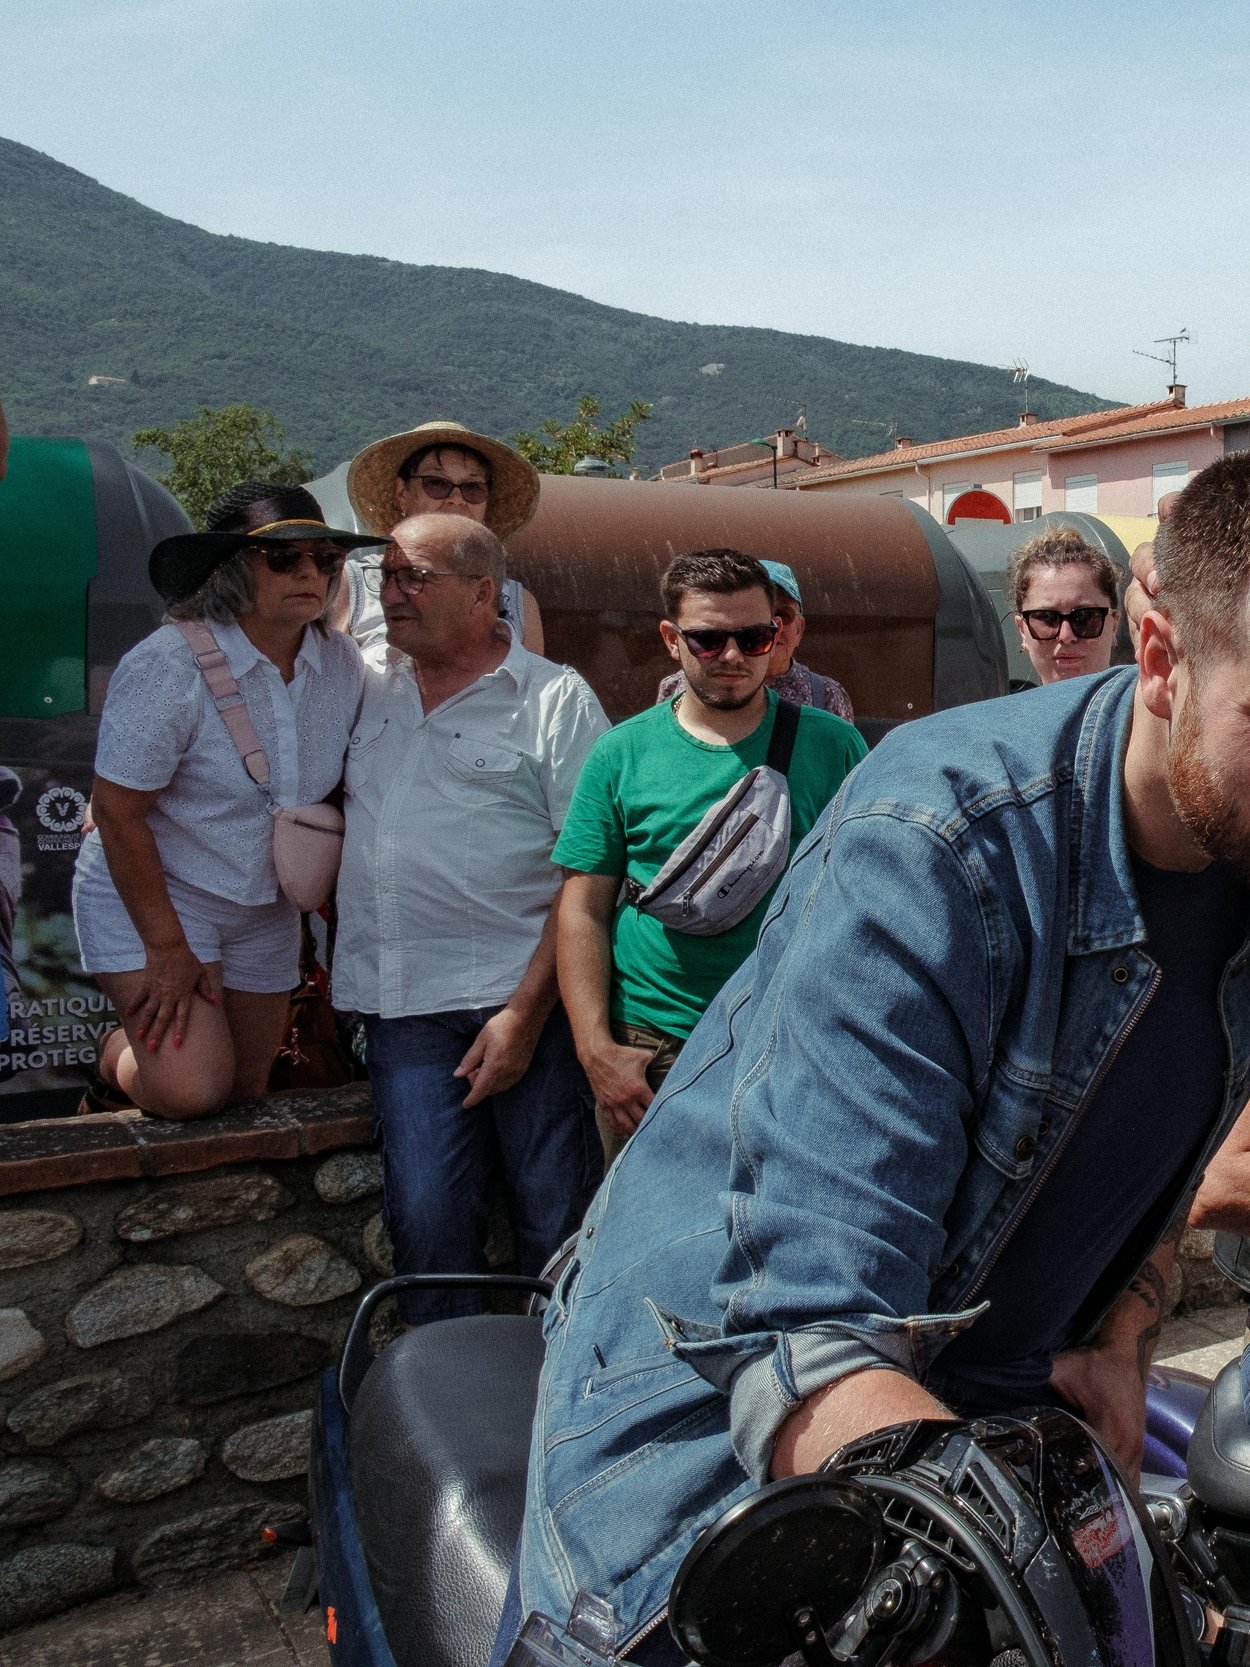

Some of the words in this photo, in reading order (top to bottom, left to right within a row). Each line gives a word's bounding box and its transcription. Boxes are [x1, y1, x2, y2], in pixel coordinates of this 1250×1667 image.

[38, 842, 81, 851] VALLESP
[717, 849, 765, 899] Champion
[10, 995, 117, 1019] RATIQU
[0, 1043, 97, 1072] PROTÈG
